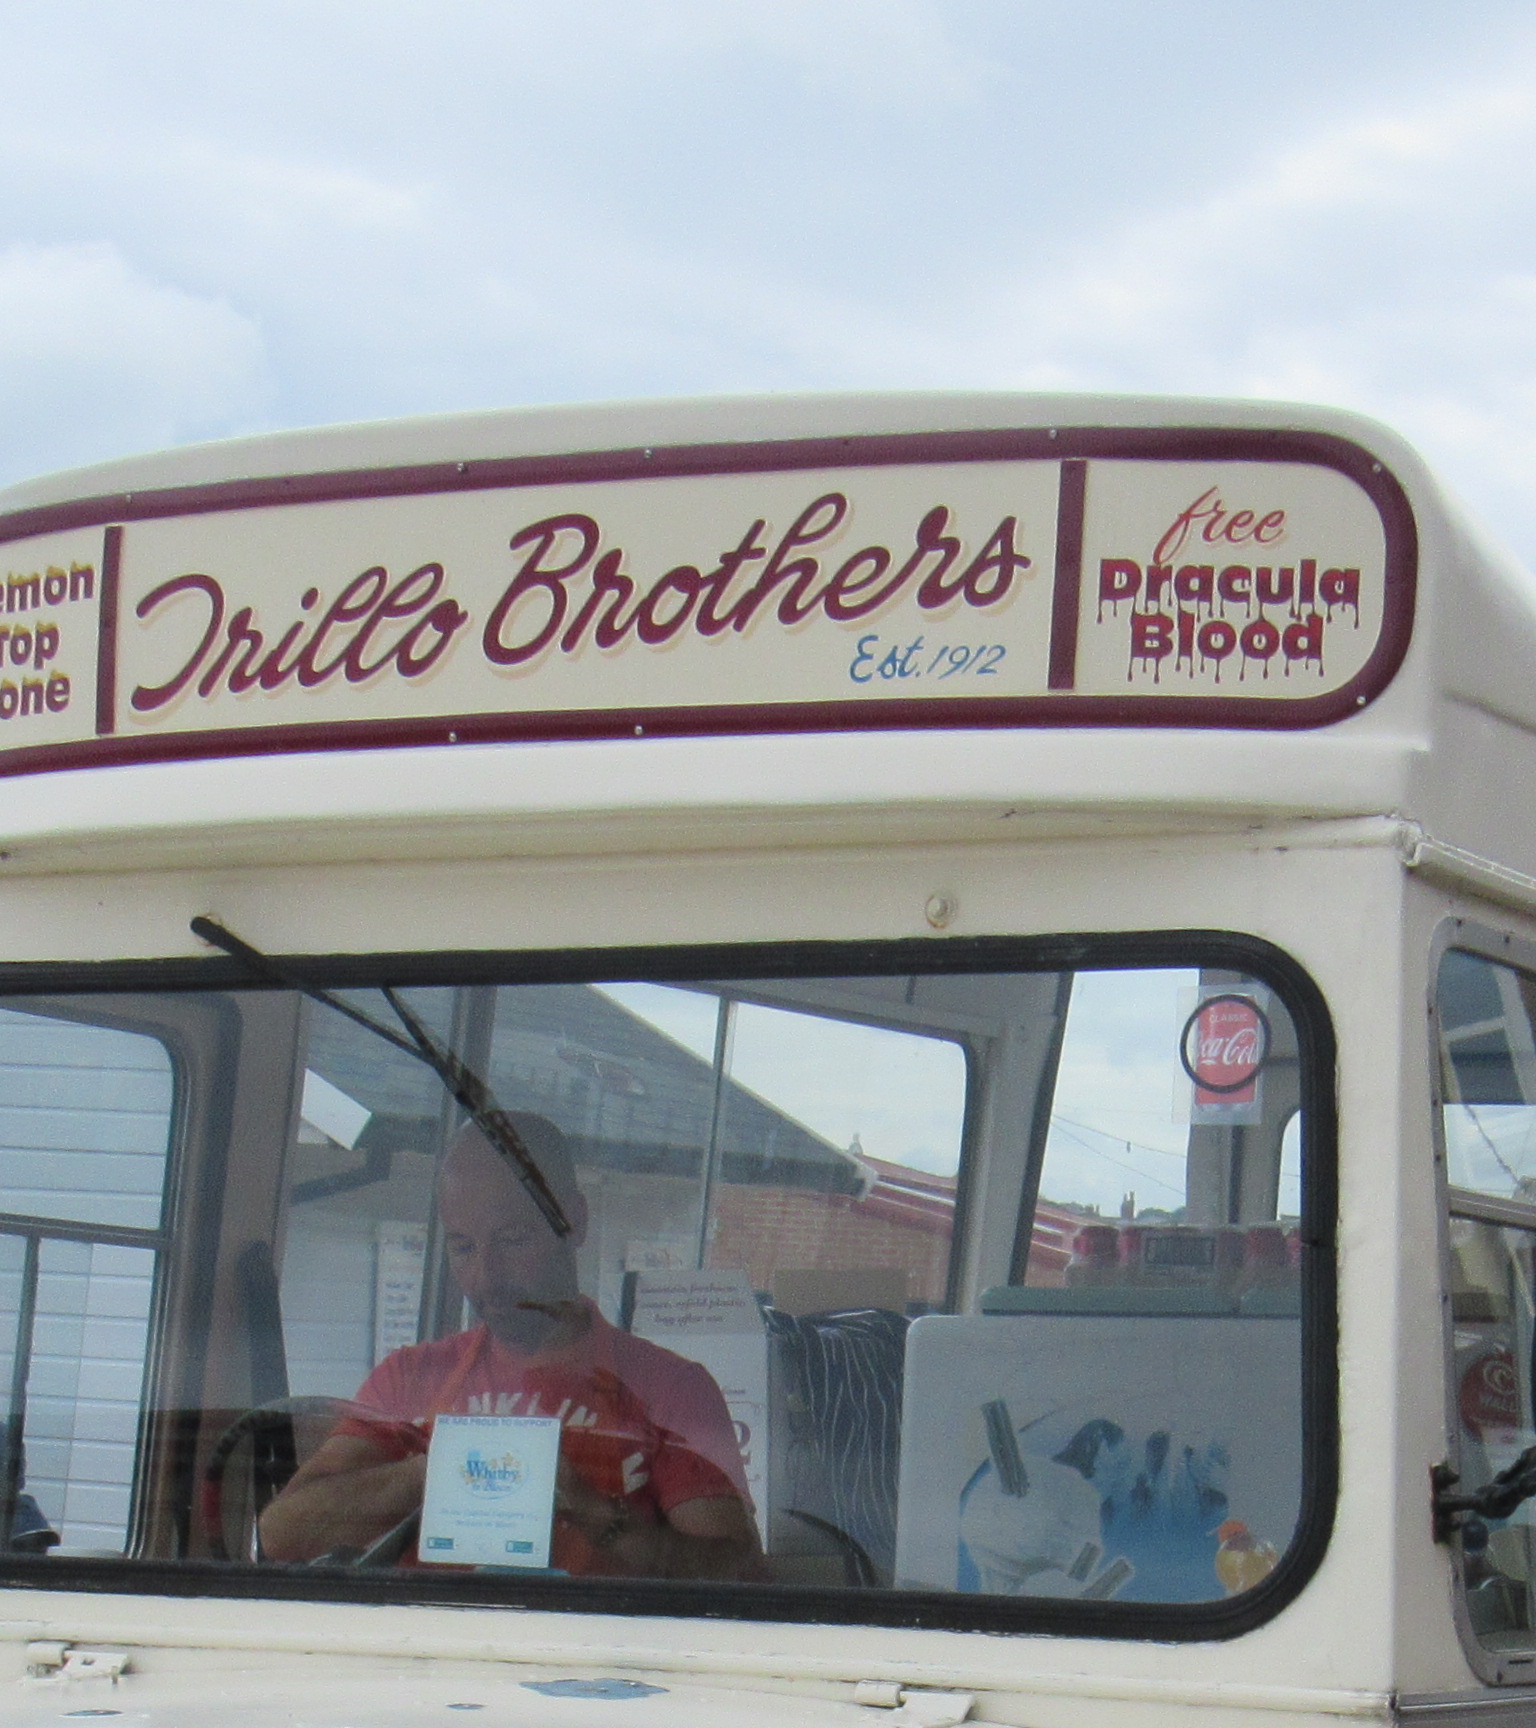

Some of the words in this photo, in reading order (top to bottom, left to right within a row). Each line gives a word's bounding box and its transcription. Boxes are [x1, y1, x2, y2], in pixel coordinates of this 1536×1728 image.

[1152, 486, 1286, 565] free
[130, 562, 469, 712] Trillo
[481, 492, 1031, 665] Brothers
[1098, 558, 1361, 626] Dracula
[927, 645, 1007, 680] 1912
[1130, 610, 1326, 680] Blood
